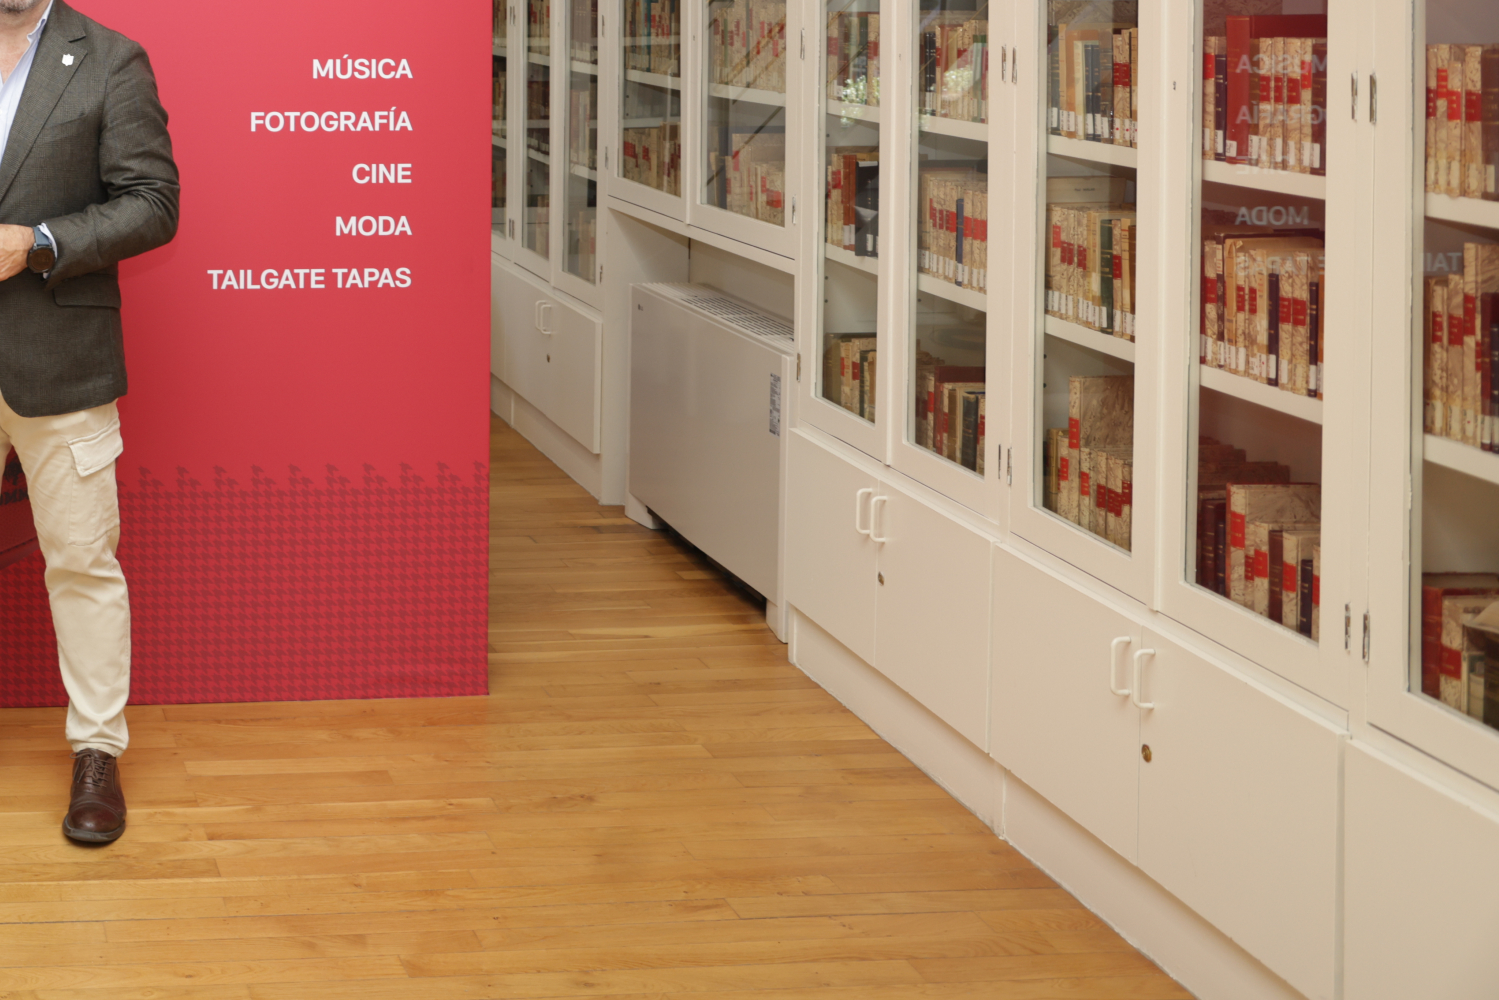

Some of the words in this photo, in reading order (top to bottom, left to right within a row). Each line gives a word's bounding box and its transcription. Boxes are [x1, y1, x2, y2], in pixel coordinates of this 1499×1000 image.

[312, 53, 413, 79] MÚSICA
[250, 106, 413, 132] FOTOGRAFÍA
[352, 163, 412, 184] CINE
[335, 215, 412, 236] MODA
[207, 268, 326, 290] TAILGATE
[332, 267, 412, 289] TAPAS
